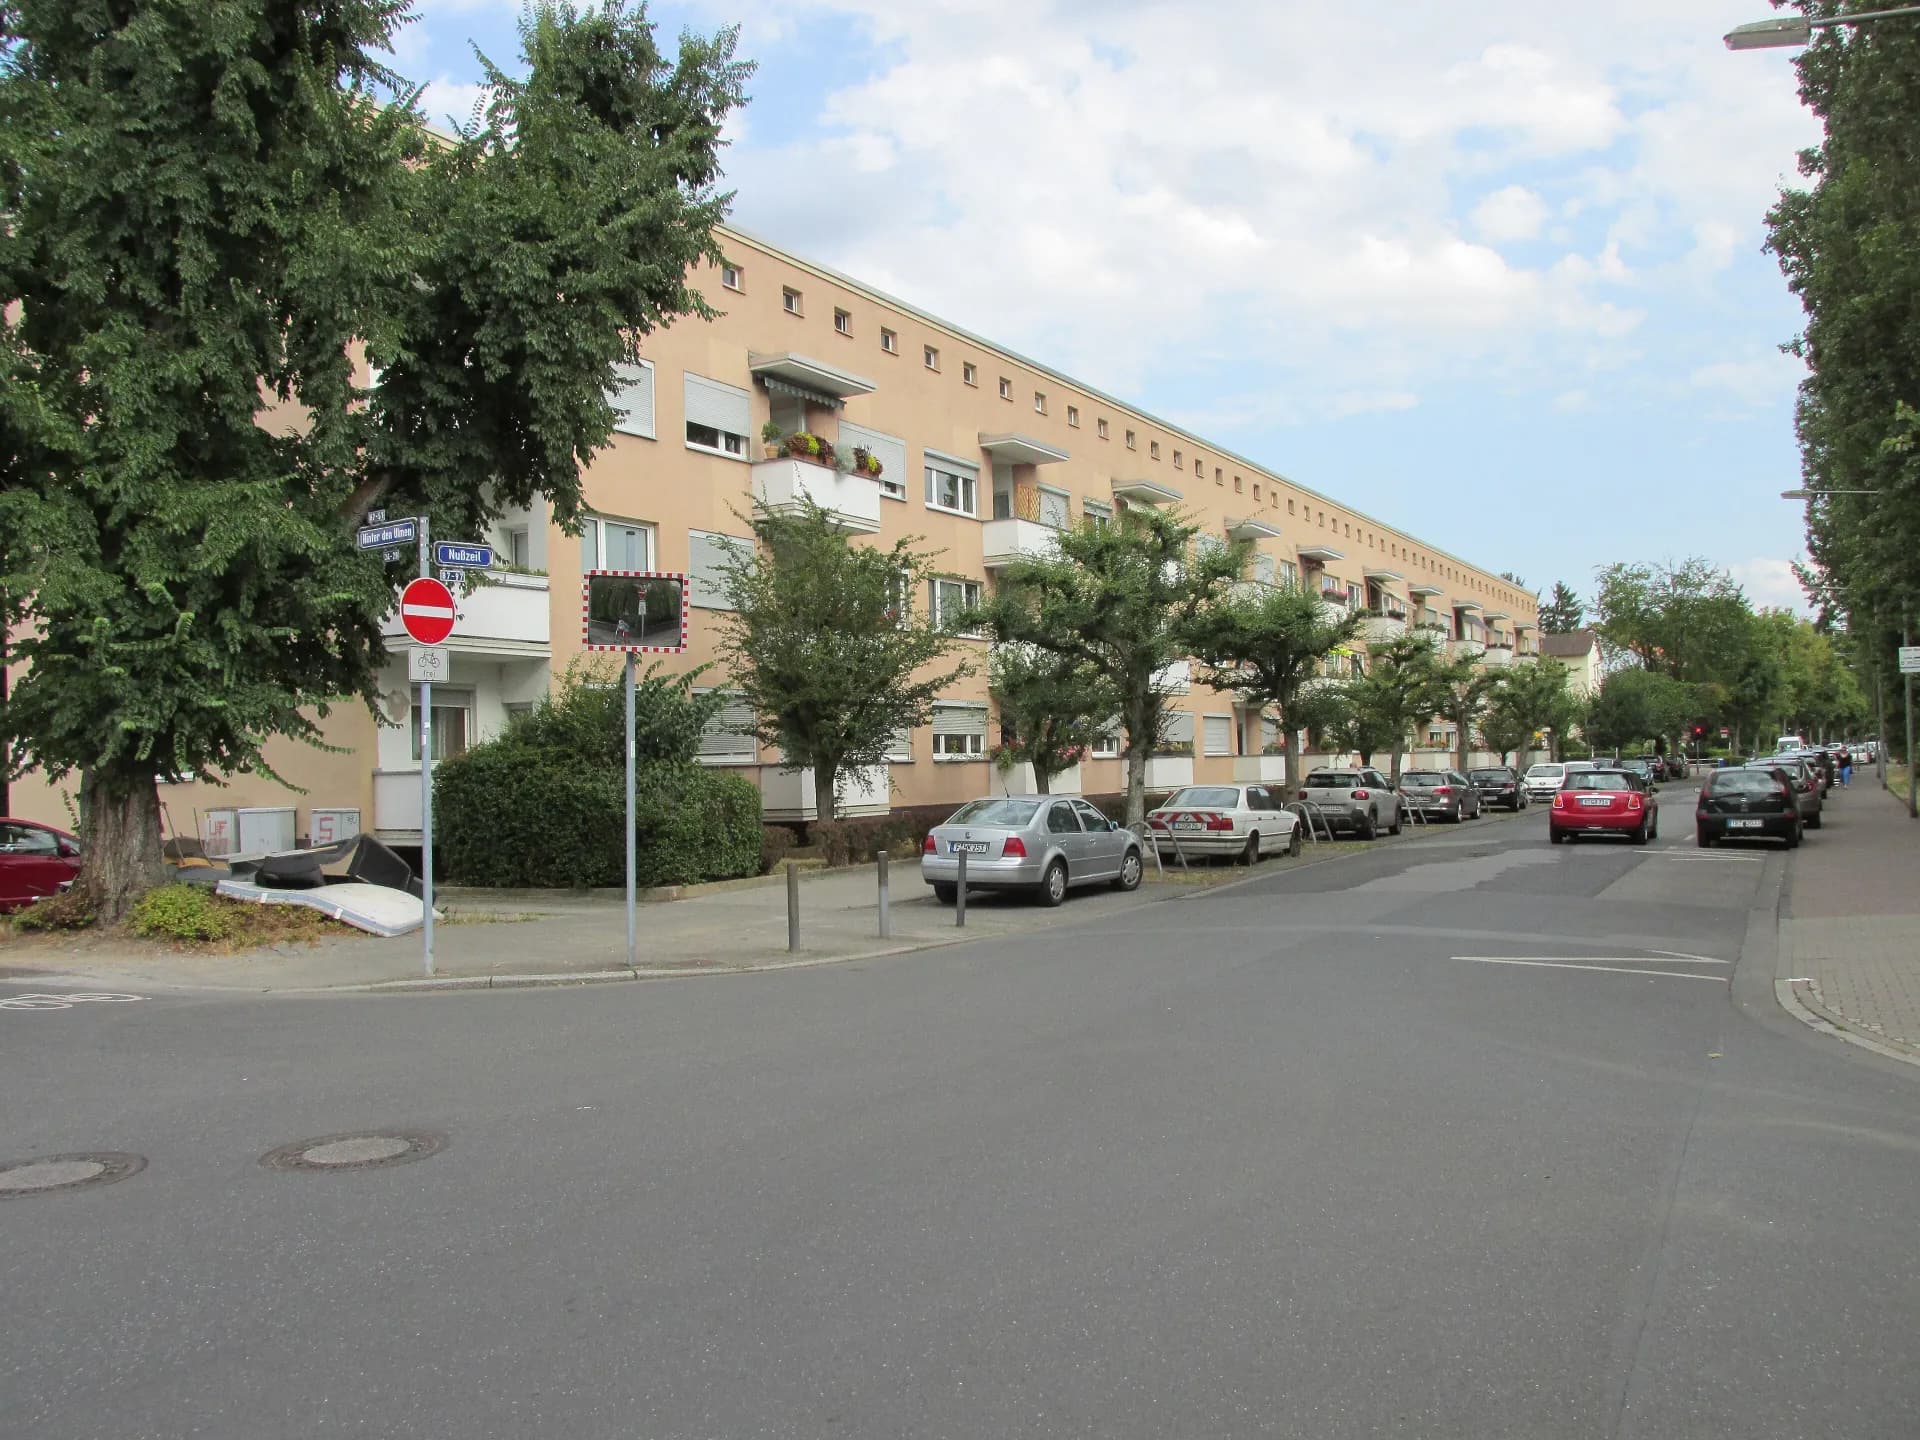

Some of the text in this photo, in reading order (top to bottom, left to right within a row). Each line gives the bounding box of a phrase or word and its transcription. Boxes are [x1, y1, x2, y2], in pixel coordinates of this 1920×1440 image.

[362, 527, 412, 545] Hinter den Ulmen
[448, 548, 482, 562] Nußzeil
